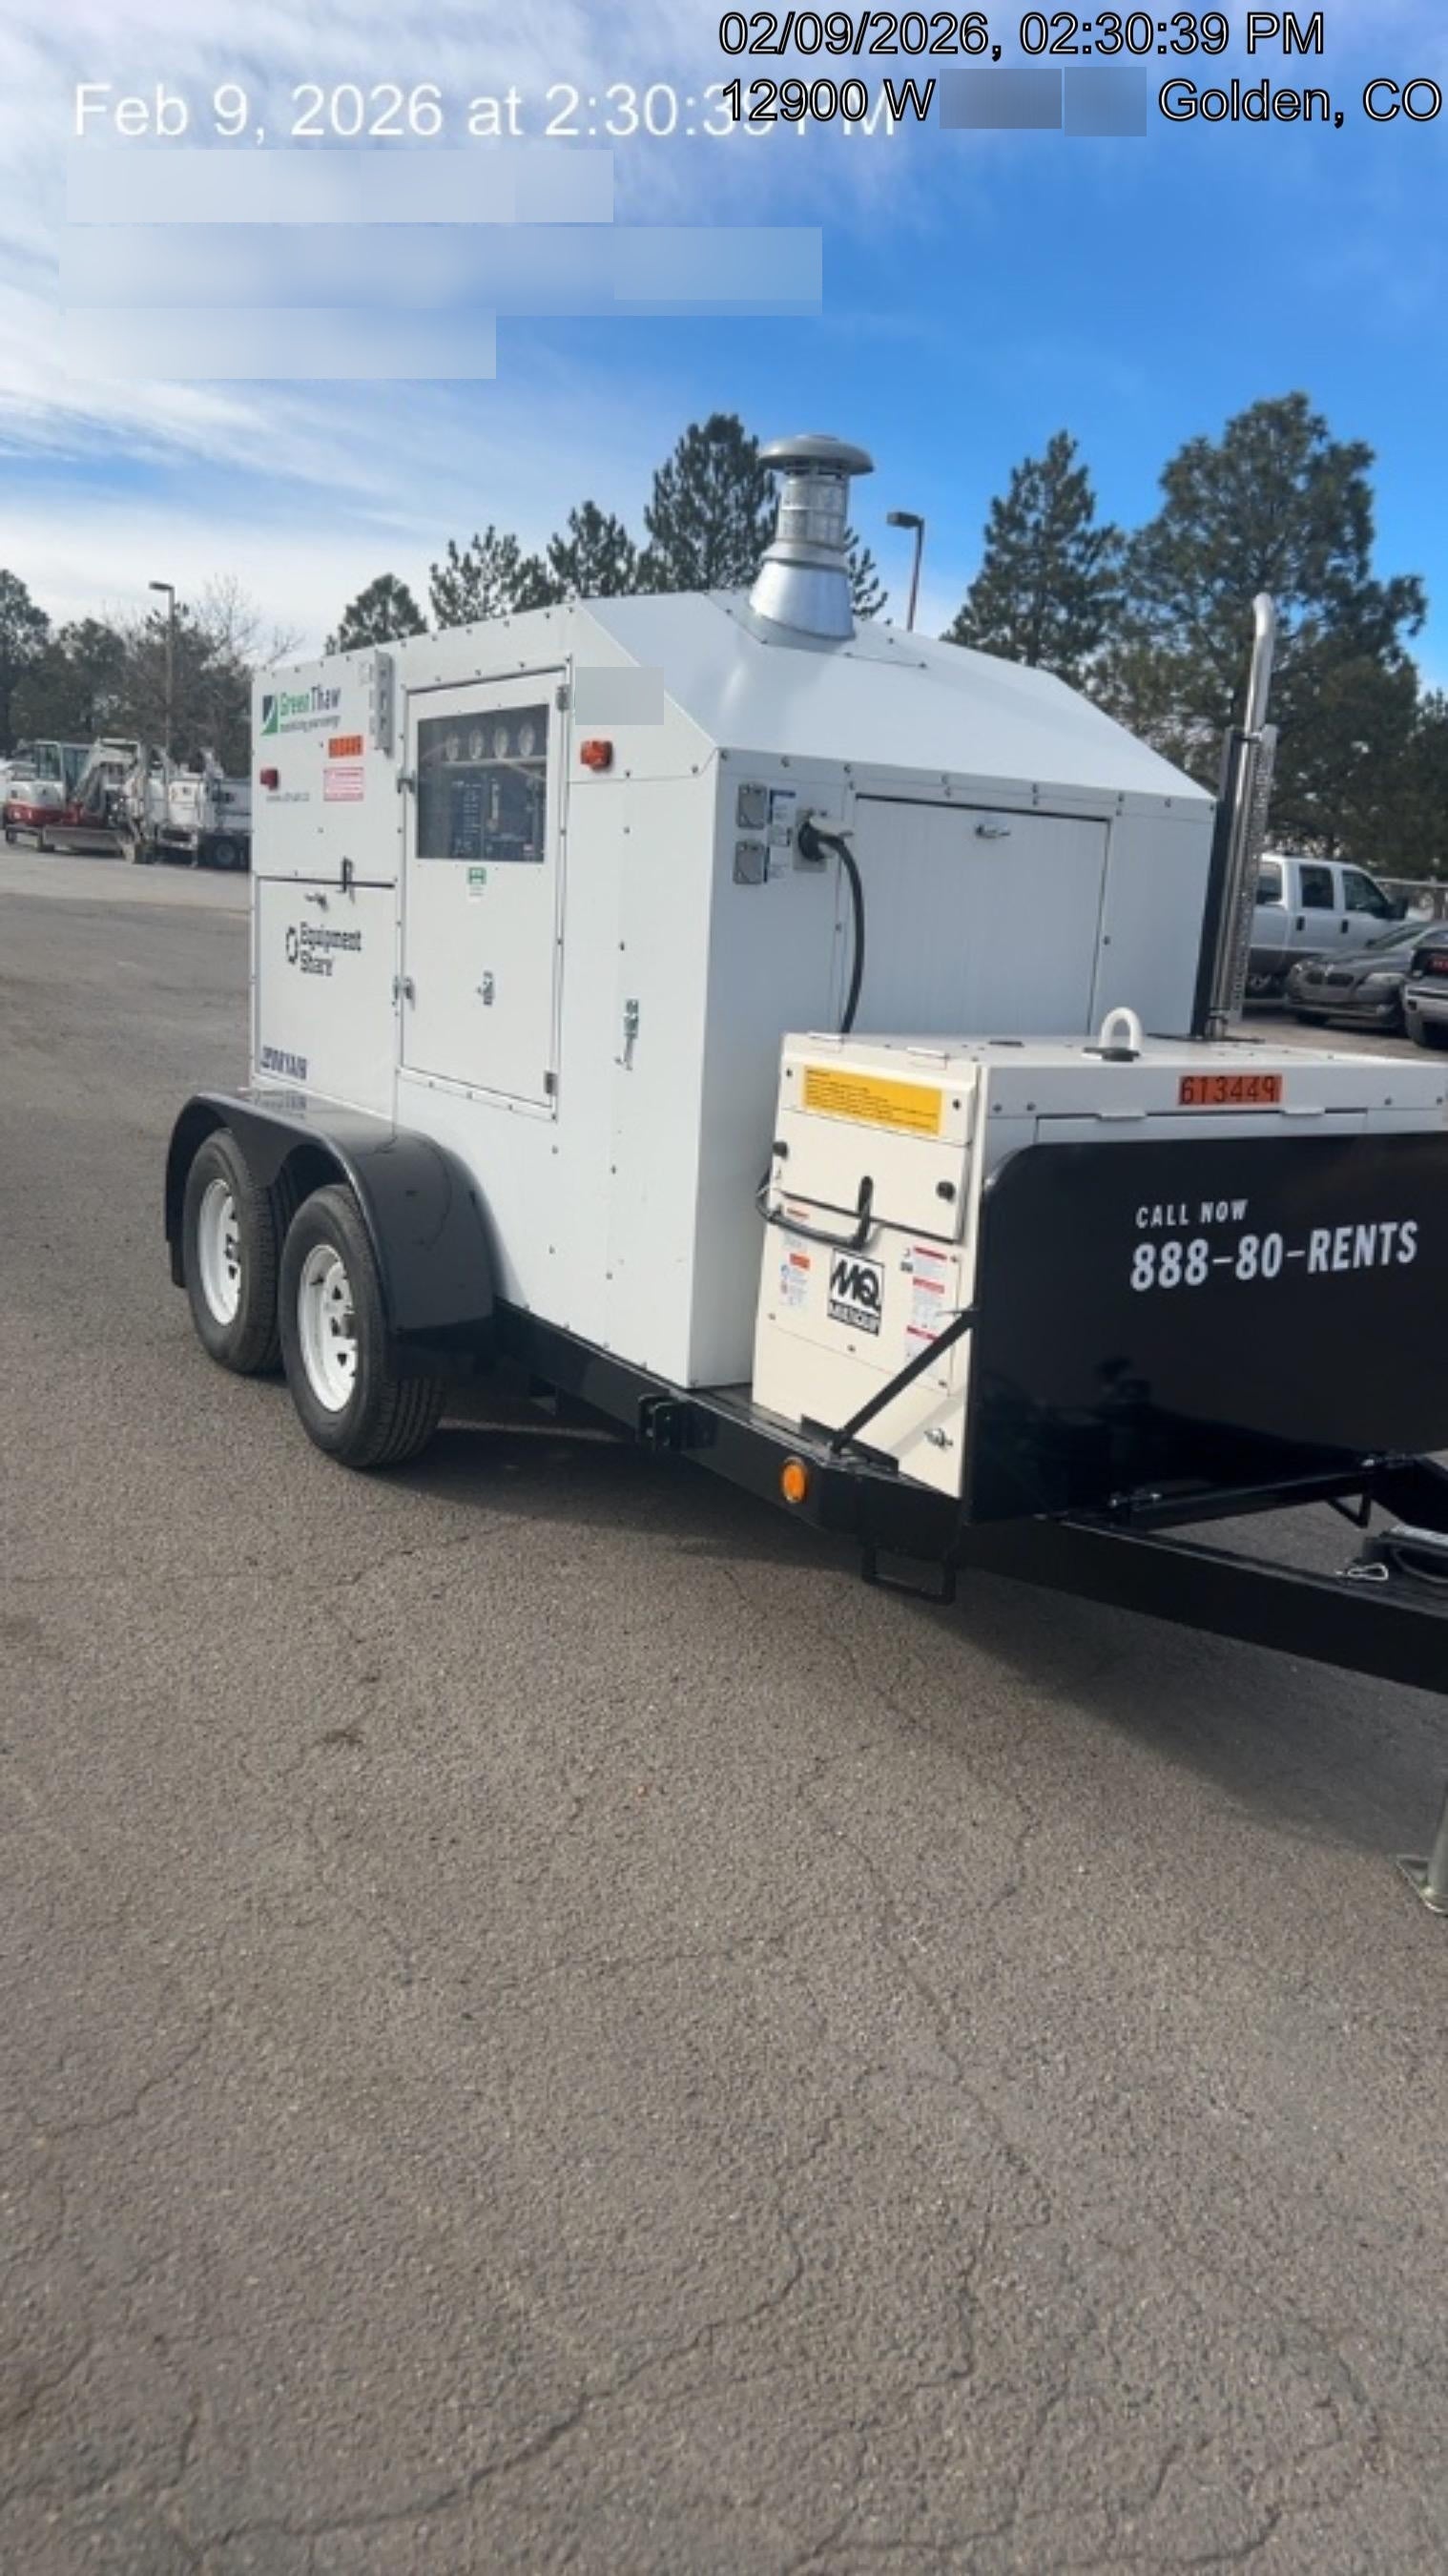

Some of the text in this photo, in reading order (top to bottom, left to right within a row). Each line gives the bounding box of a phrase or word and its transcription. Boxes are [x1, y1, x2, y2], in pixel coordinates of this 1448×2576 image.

[1180, 1075, 1277, 1104] 613449
[1136, 1198, 1249, 1229] CALL NOW
[1129, 1219, 1418, 1291] 888-80-RENTS
